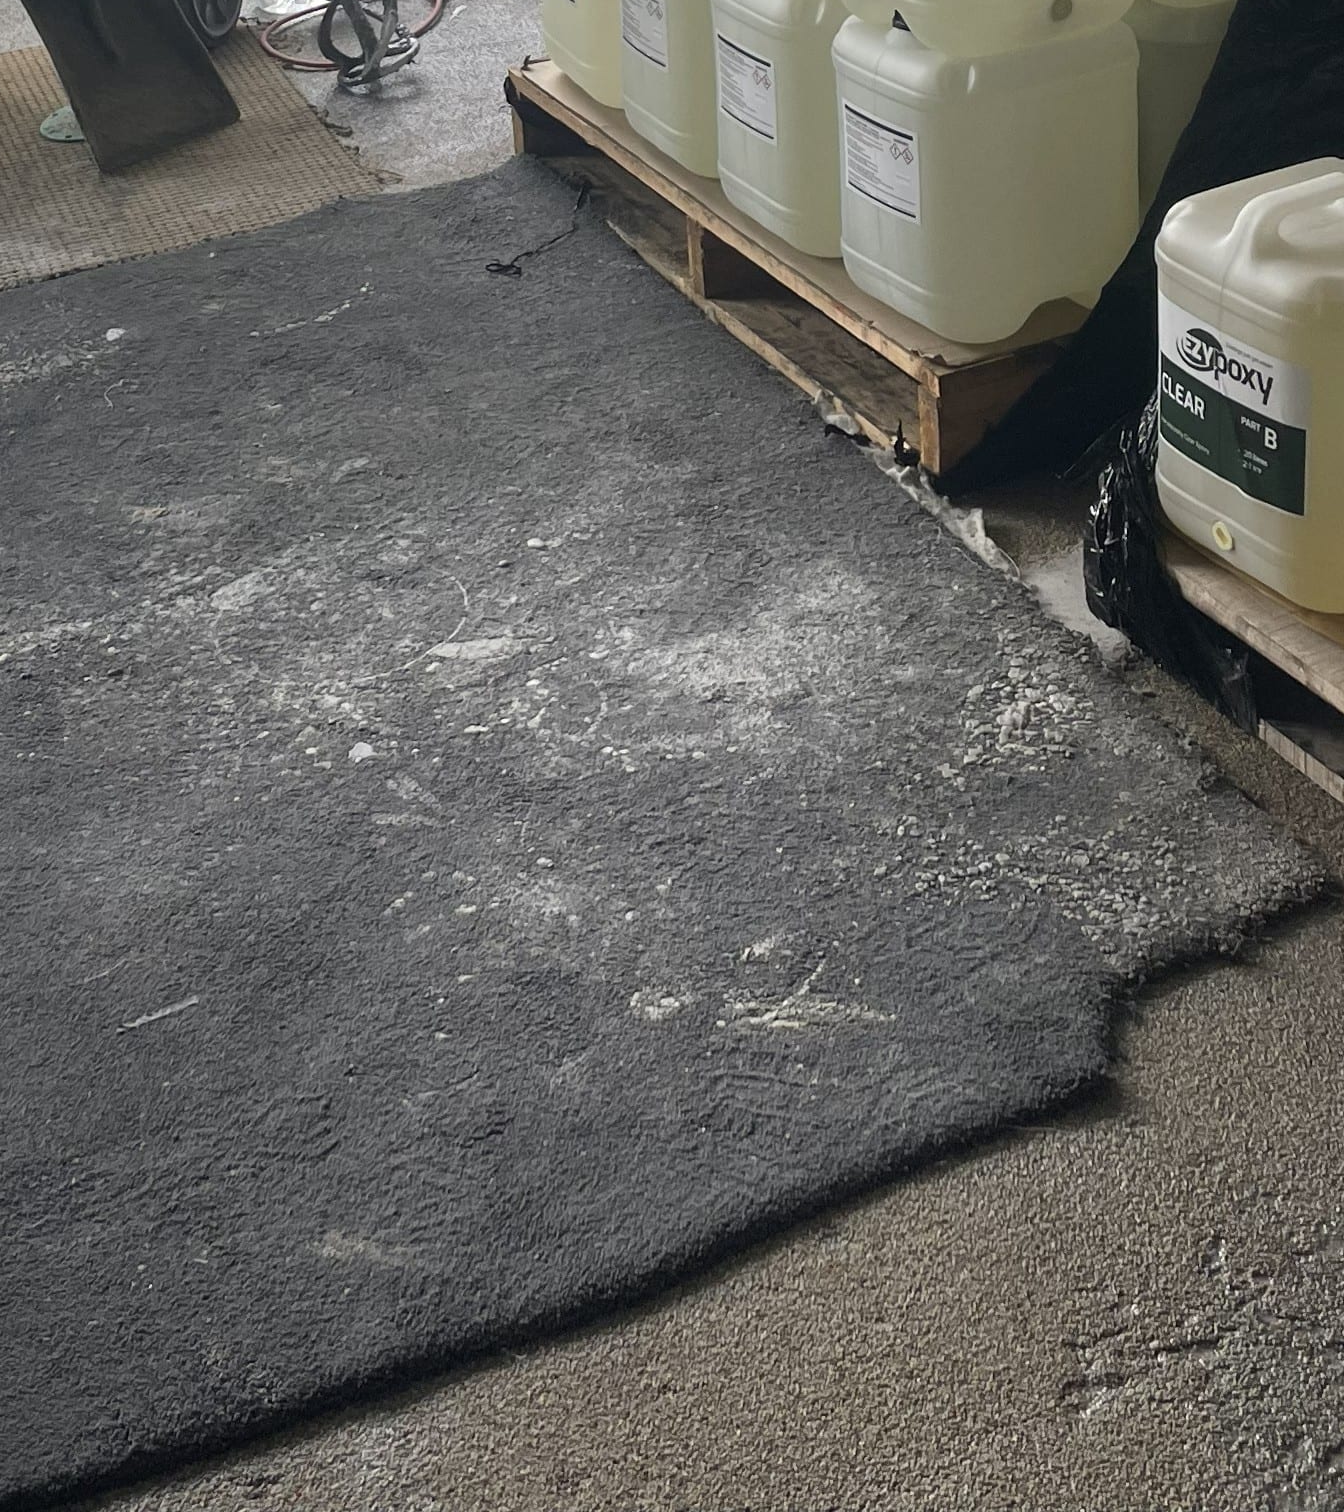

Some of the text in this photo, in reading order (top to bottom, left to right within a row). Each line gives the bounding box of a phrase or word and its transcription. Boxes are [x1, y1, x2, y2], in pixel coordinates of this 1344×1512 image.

[1184, 333, 1274, 405] EZYpoxy
[1162, 372, 1205, 420] CLEAR
[1240, 416, 1278, 450] PART B
